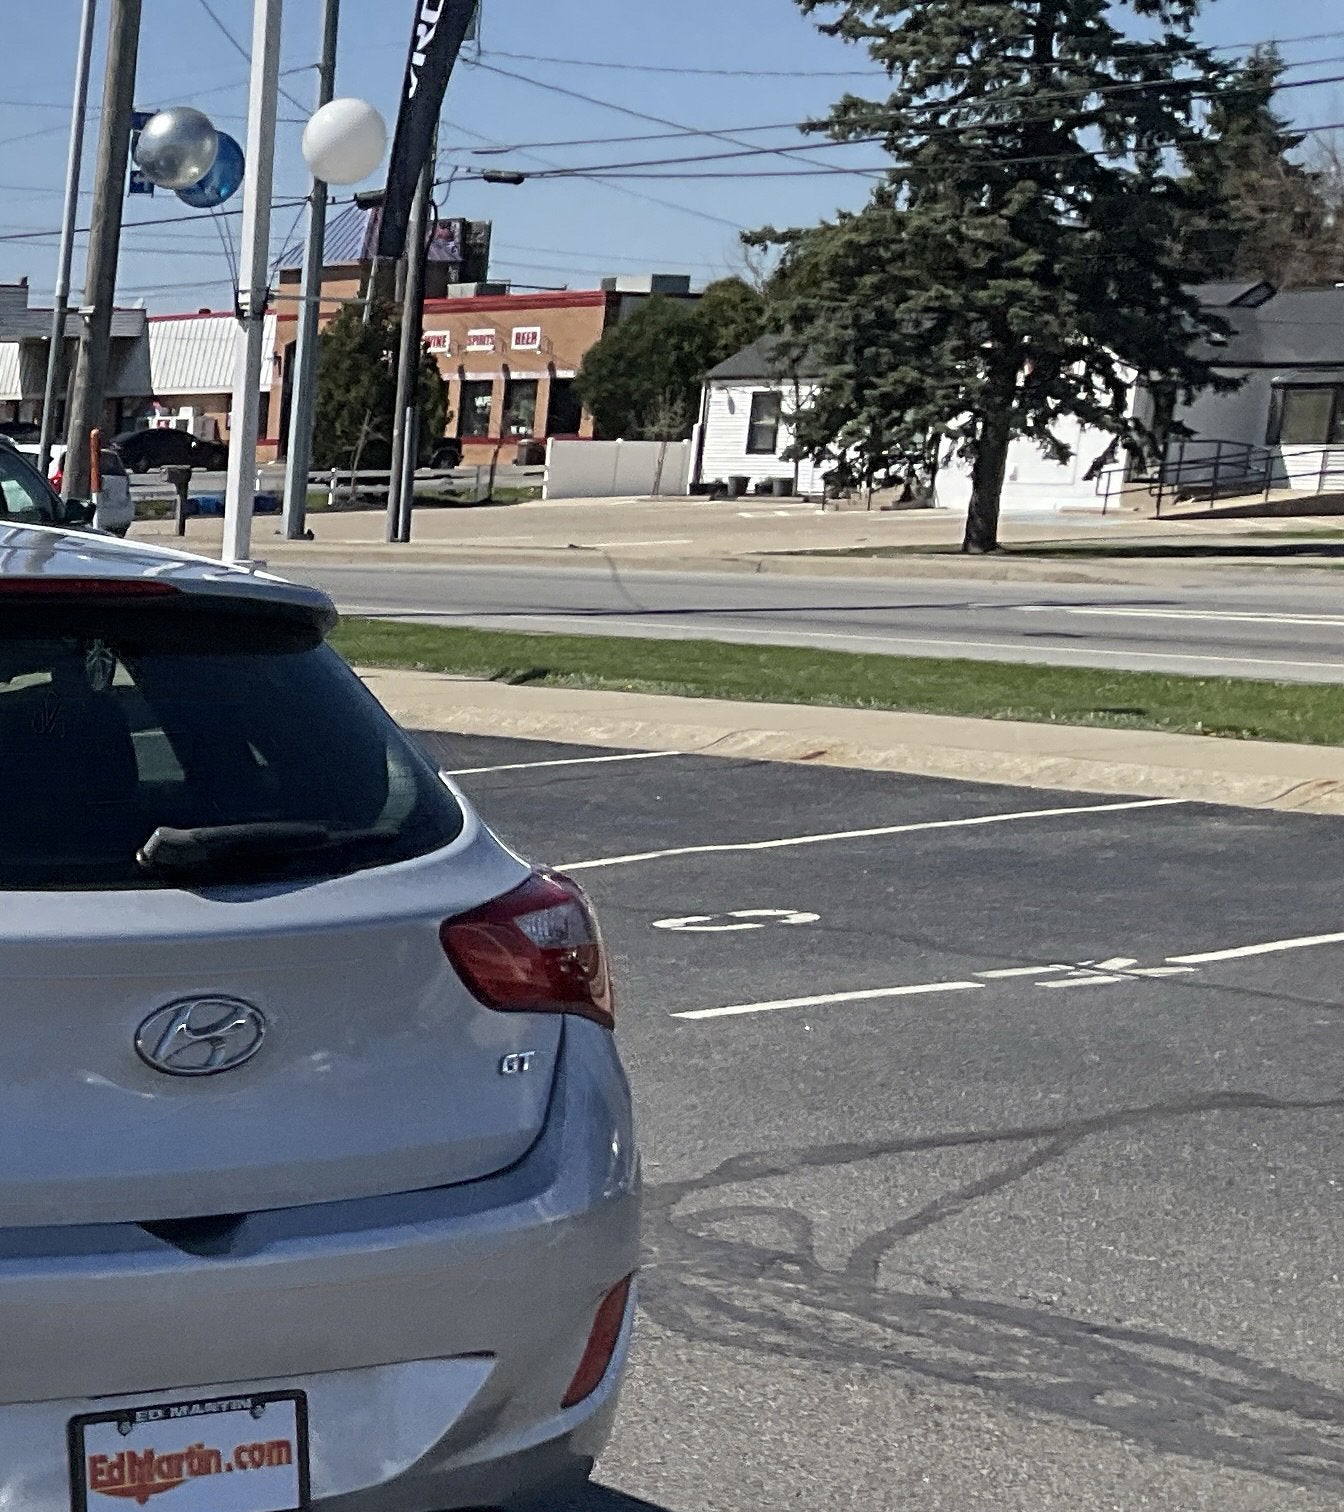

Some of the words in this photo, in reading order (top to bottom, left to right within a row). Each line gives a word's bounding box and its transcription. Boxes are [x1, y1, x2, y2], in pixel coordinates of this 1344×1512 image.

[515, 331, 538, 346] BEER
[501, 1050, 536, 1074] GT
[135, 1410, 163, 1423] ED
[170, 1399, 252, 1418] MARTIN
[88, 1439, 292, 1489] EdMartin.com
